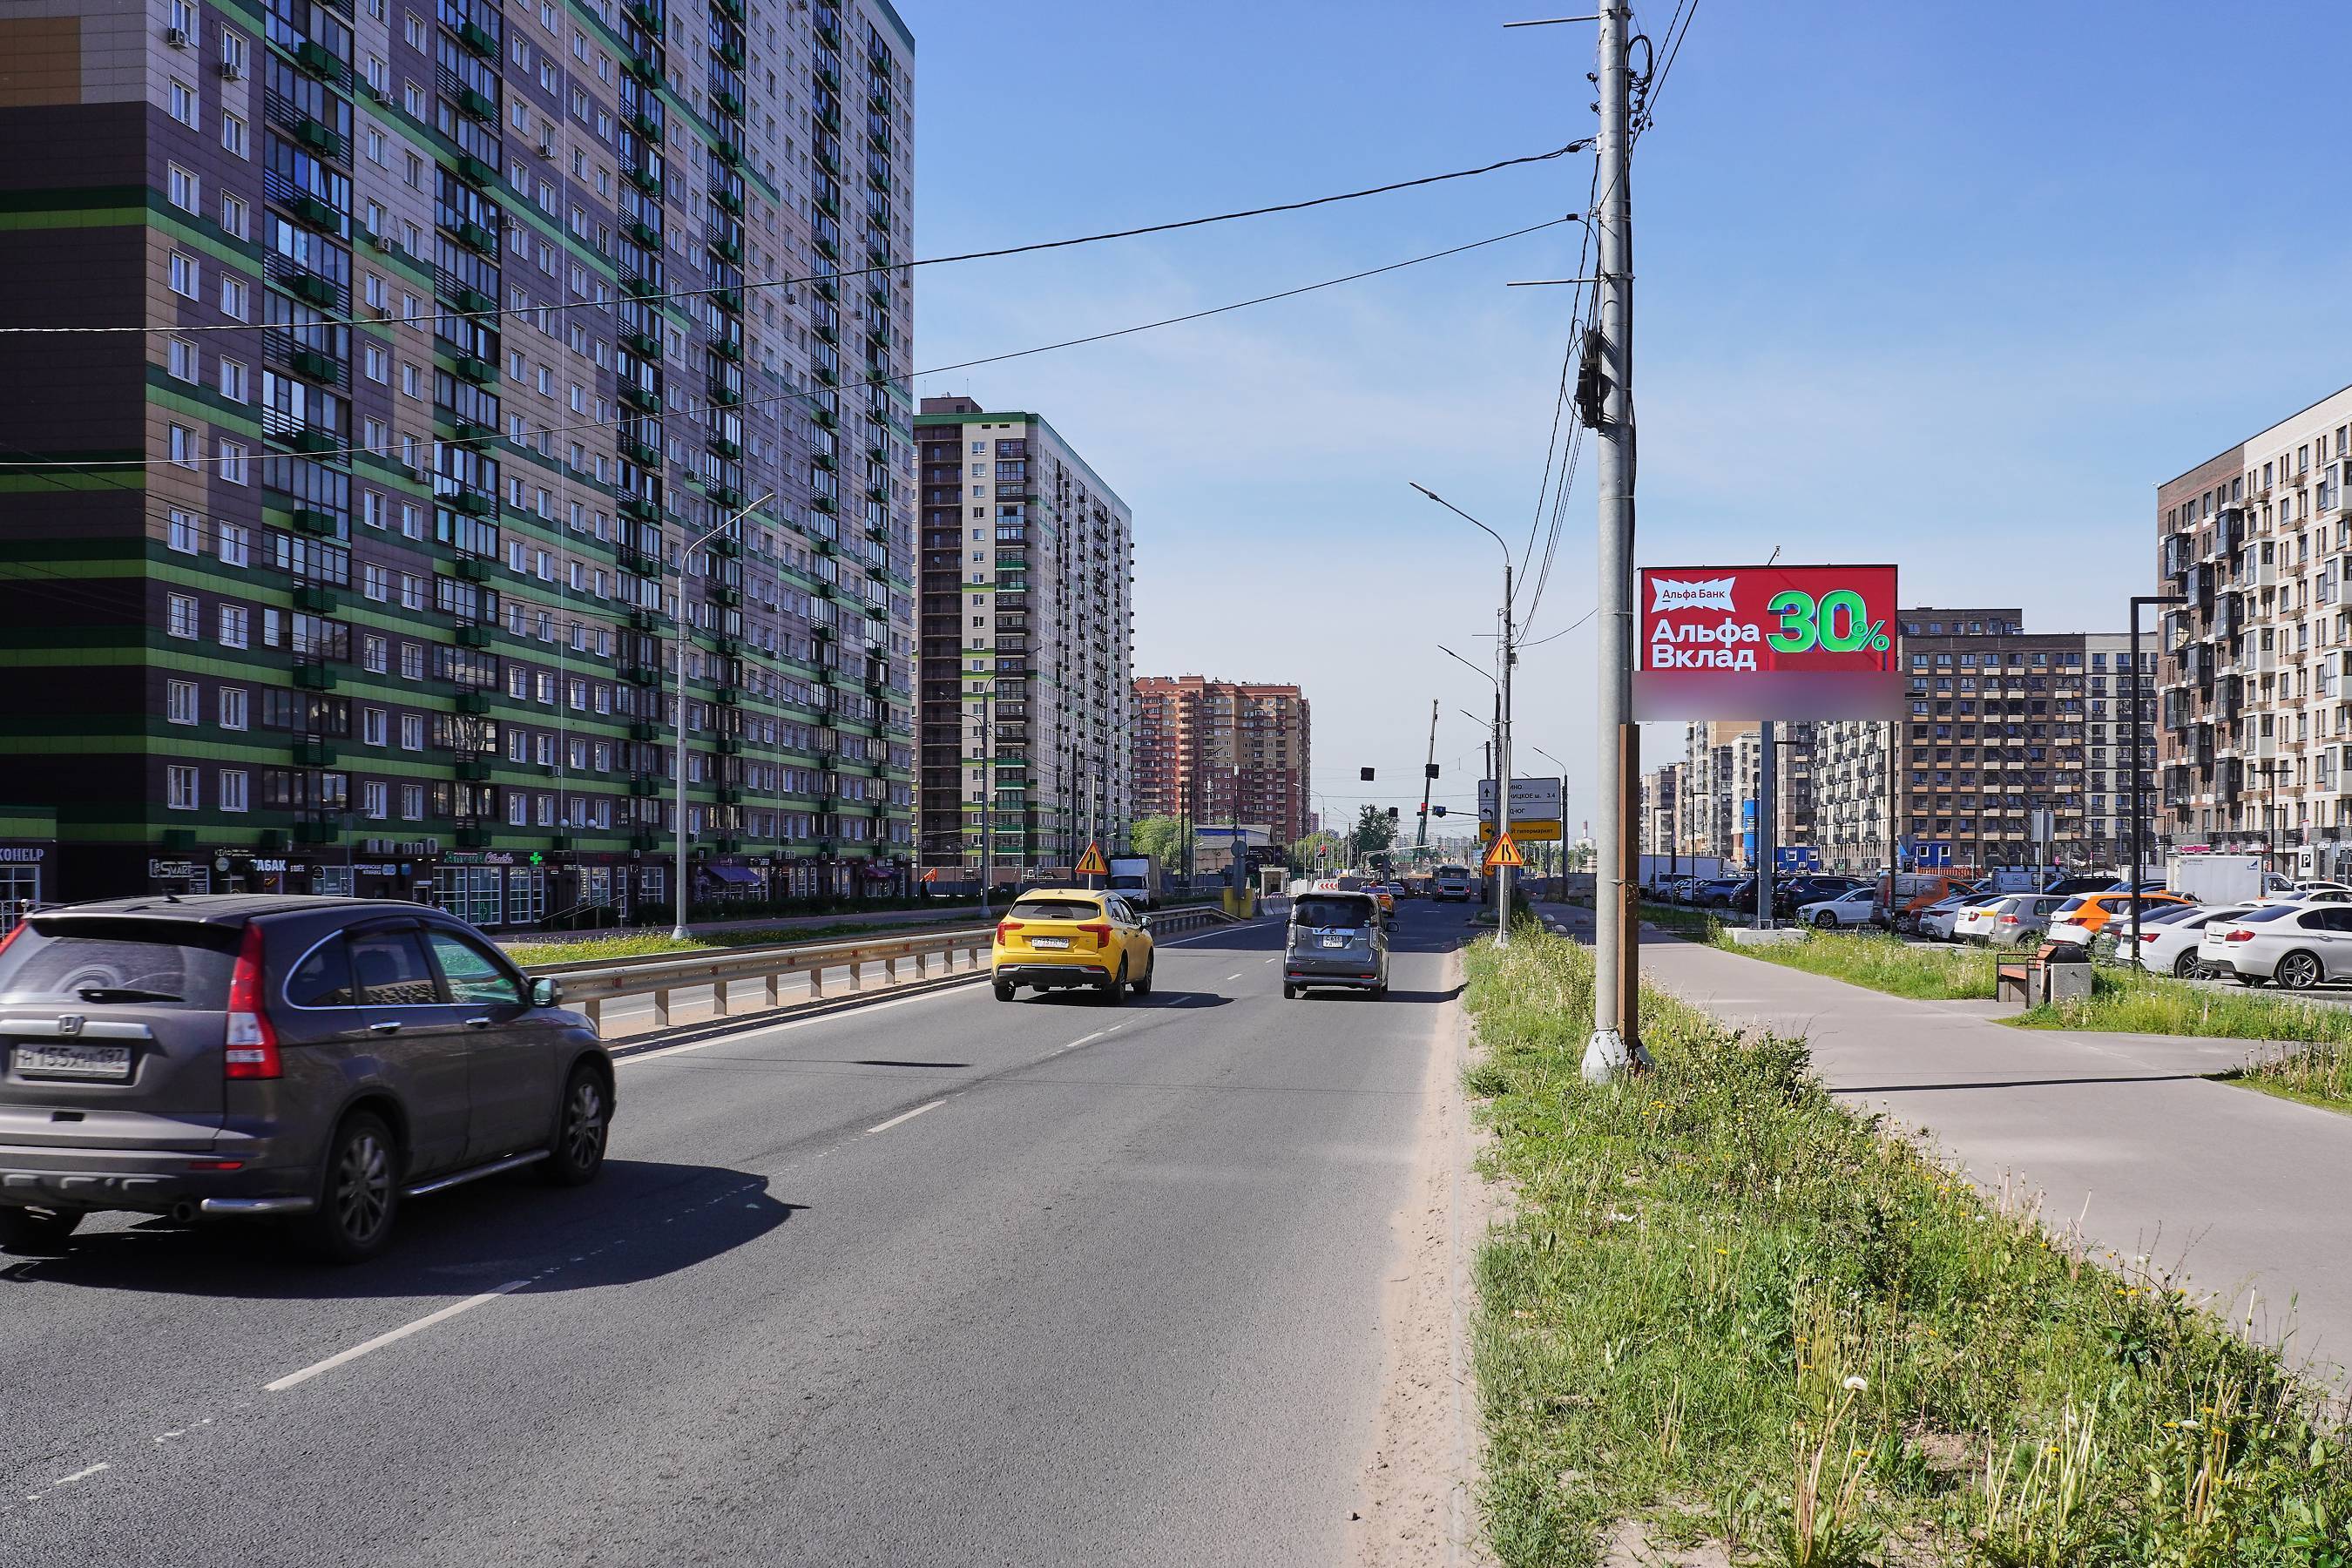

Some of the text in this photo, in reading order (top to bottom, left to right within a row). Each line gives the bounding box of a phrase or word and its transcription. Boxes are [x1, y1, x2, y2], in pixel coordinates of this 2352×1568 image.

[1662, 589, 1726, 601] Альфа Банк
[1651, 617, 1760, 648] Альфа
[1766, 590, 1890, 652] 30%
[1652, 644, 1757, 671] Вклад
